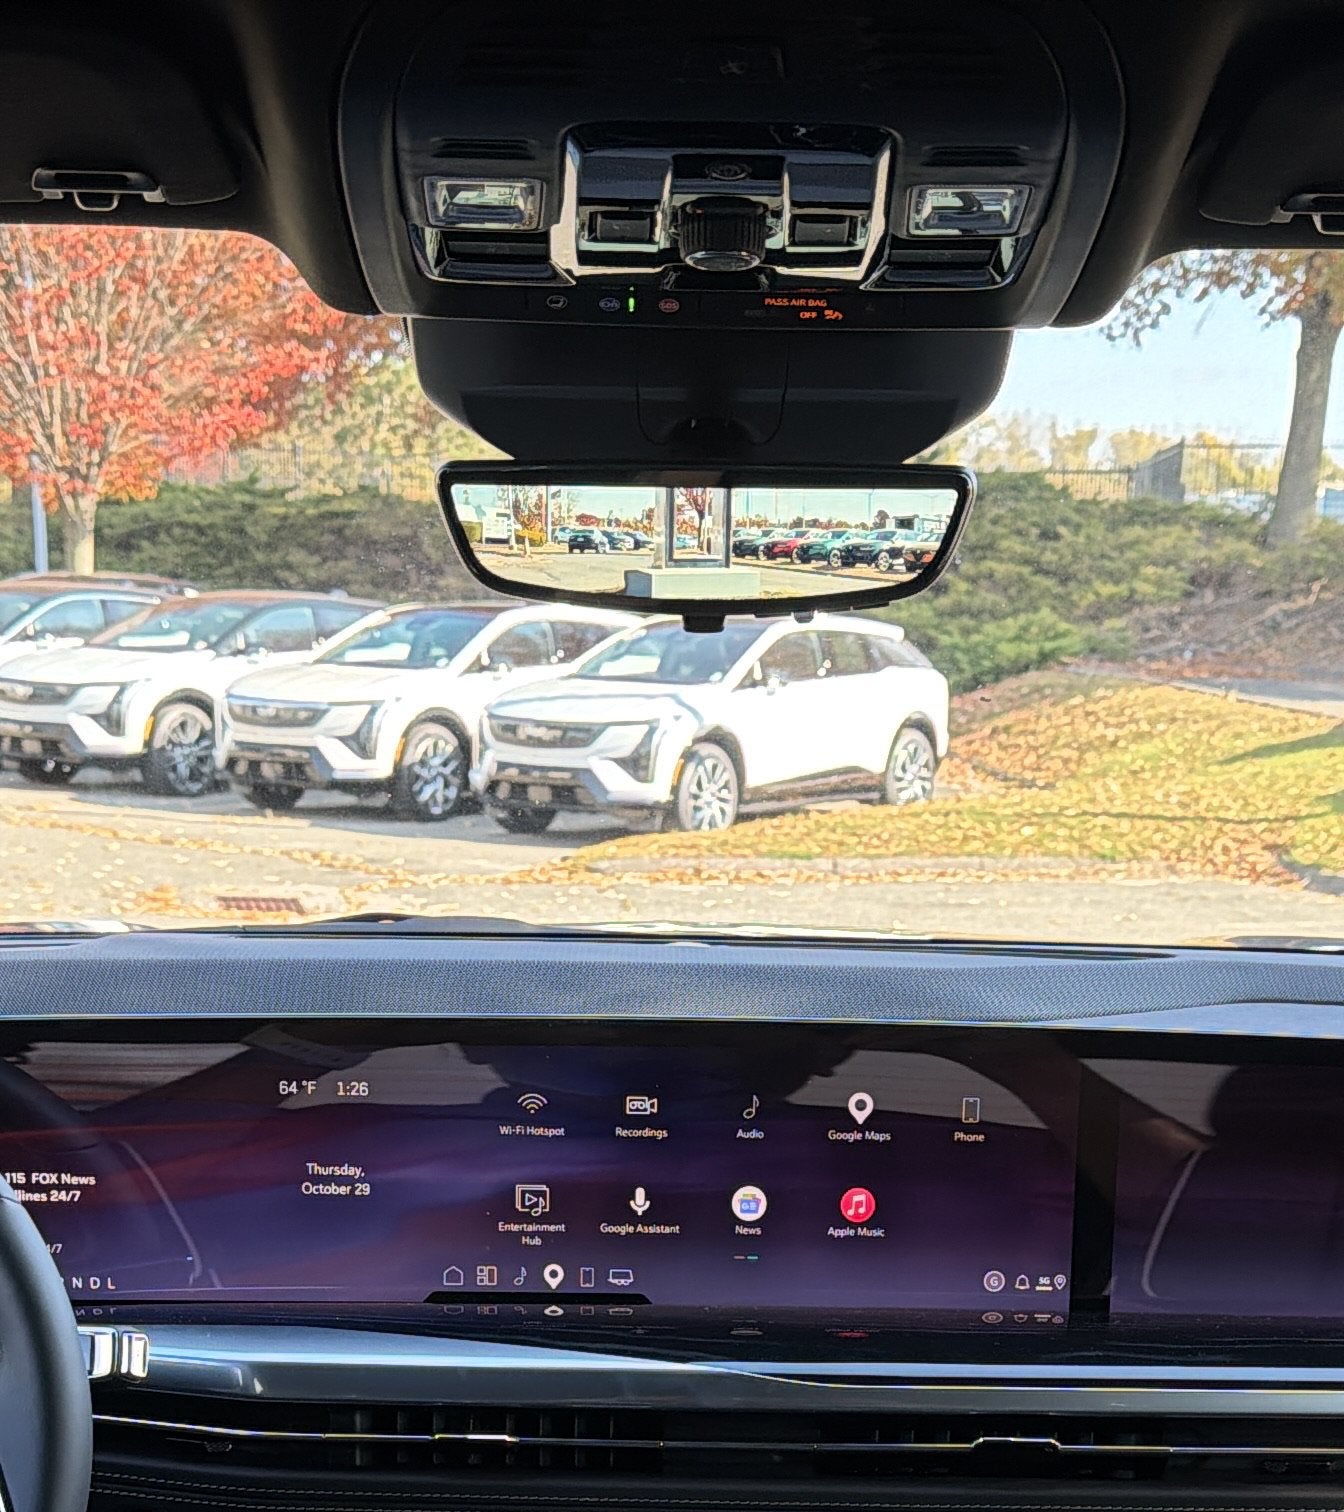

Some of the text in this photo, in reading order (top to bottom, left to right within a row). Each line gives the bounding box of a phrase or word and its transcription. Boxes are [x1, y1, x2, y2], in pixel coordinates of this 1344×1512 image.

[764, 297, 827, 307] PASS AIR BAG
[800, 311, 817, 319] OFF
[279, 1080, 317, 1095] 64 °F
[337, 1081, 369, 1096] 1:26
[499, 1125, 565, 1138] Wi-Fi Hotspot
[615, 1127, 668, 1139] Recordings
[736, 1129, 764, 1140] Audio
[828, 1130, 891, 1142] Google Maps
[954, 1131, 985, 1142] Phone
[31, 1173, 59, 1185] FOX
[61, 1174, 96, 1186] News
[301, 1181, 371, 1196] October 29
[50, 1190, 81, 1202] 24/7
[498, 1221, 565, 1233] Entertainment
[600, 1223, 681, 1236] Google Assistant
[735, 1225, 762, 1236] News
[827, 1226, 885, 1238] Apple Music
[521, 1235, 542, 1246] Hub
[1038, 1276, 1051, 1285] 5G
